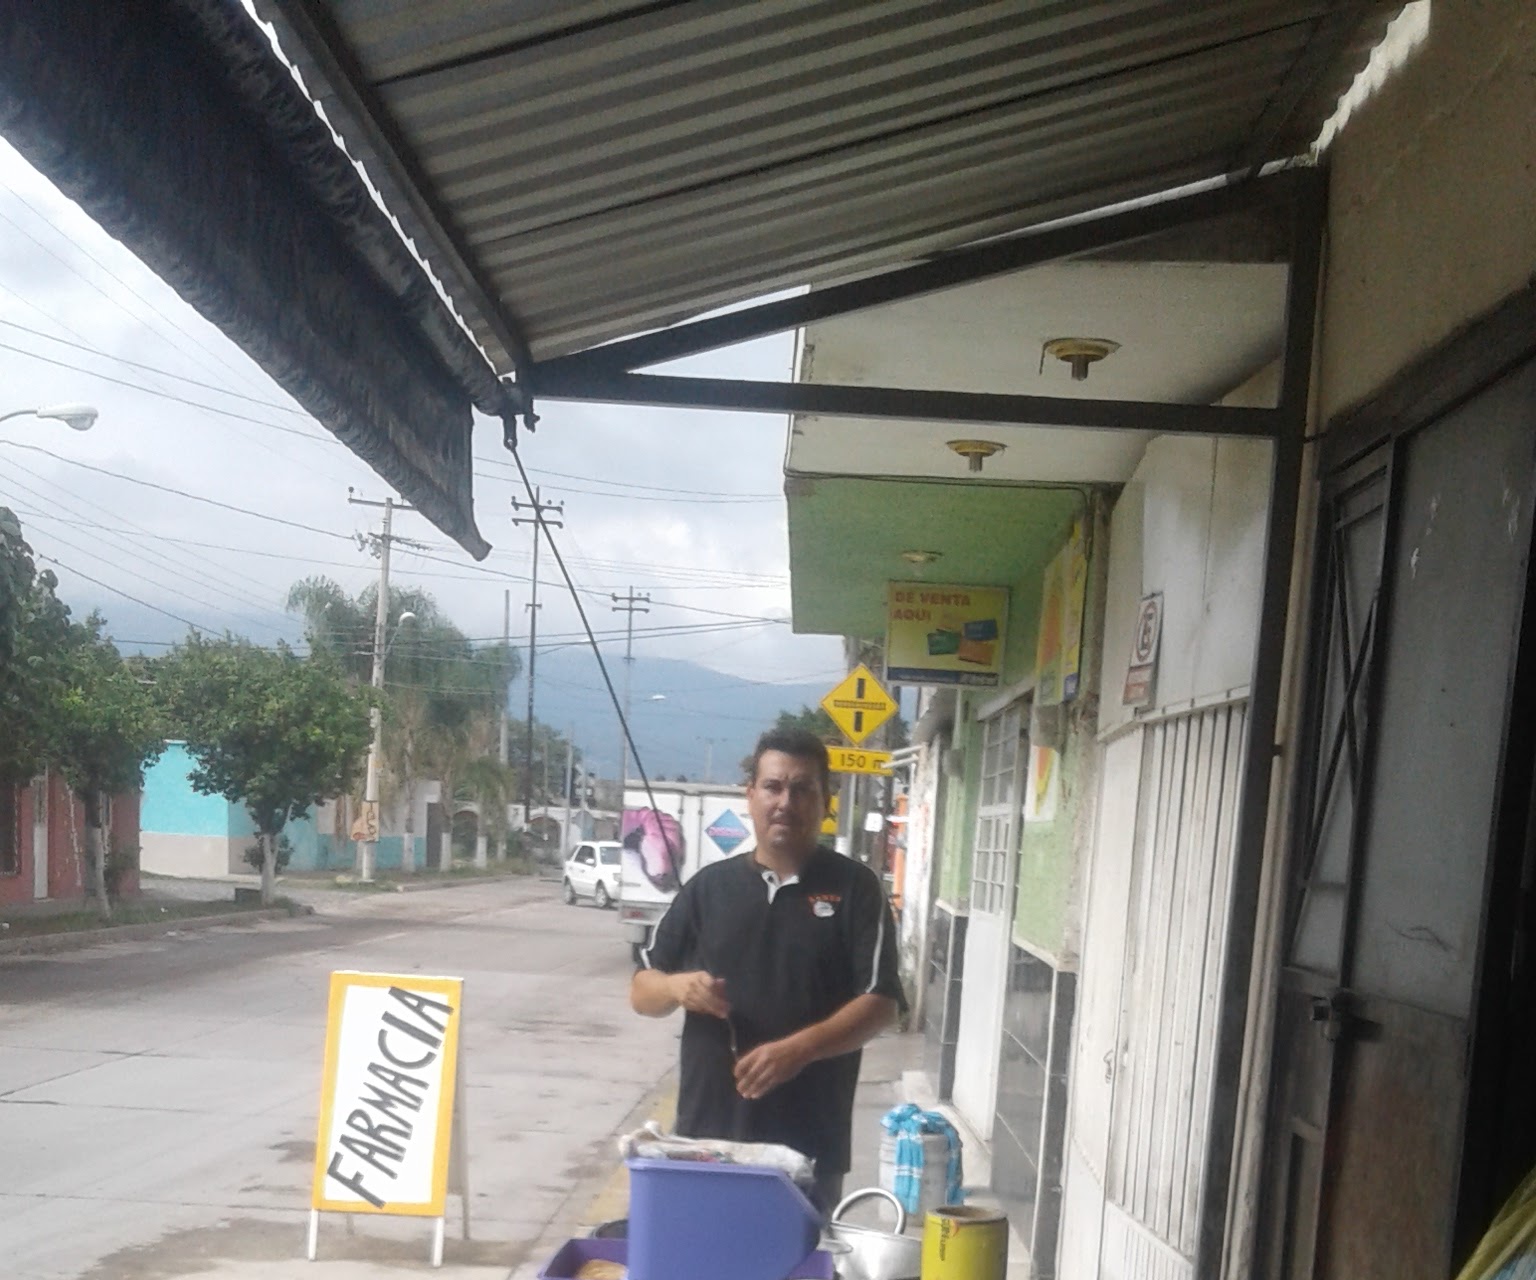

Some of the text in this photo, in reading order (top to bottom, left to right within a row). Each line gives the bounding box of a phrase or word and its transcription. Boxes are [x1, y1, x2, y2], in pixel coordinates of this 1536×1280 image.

[895, 591, 971, 606] DE VENTA
[840, 753, 866, 768] 150
[327, 986, 455, 1210] FARMACIA
